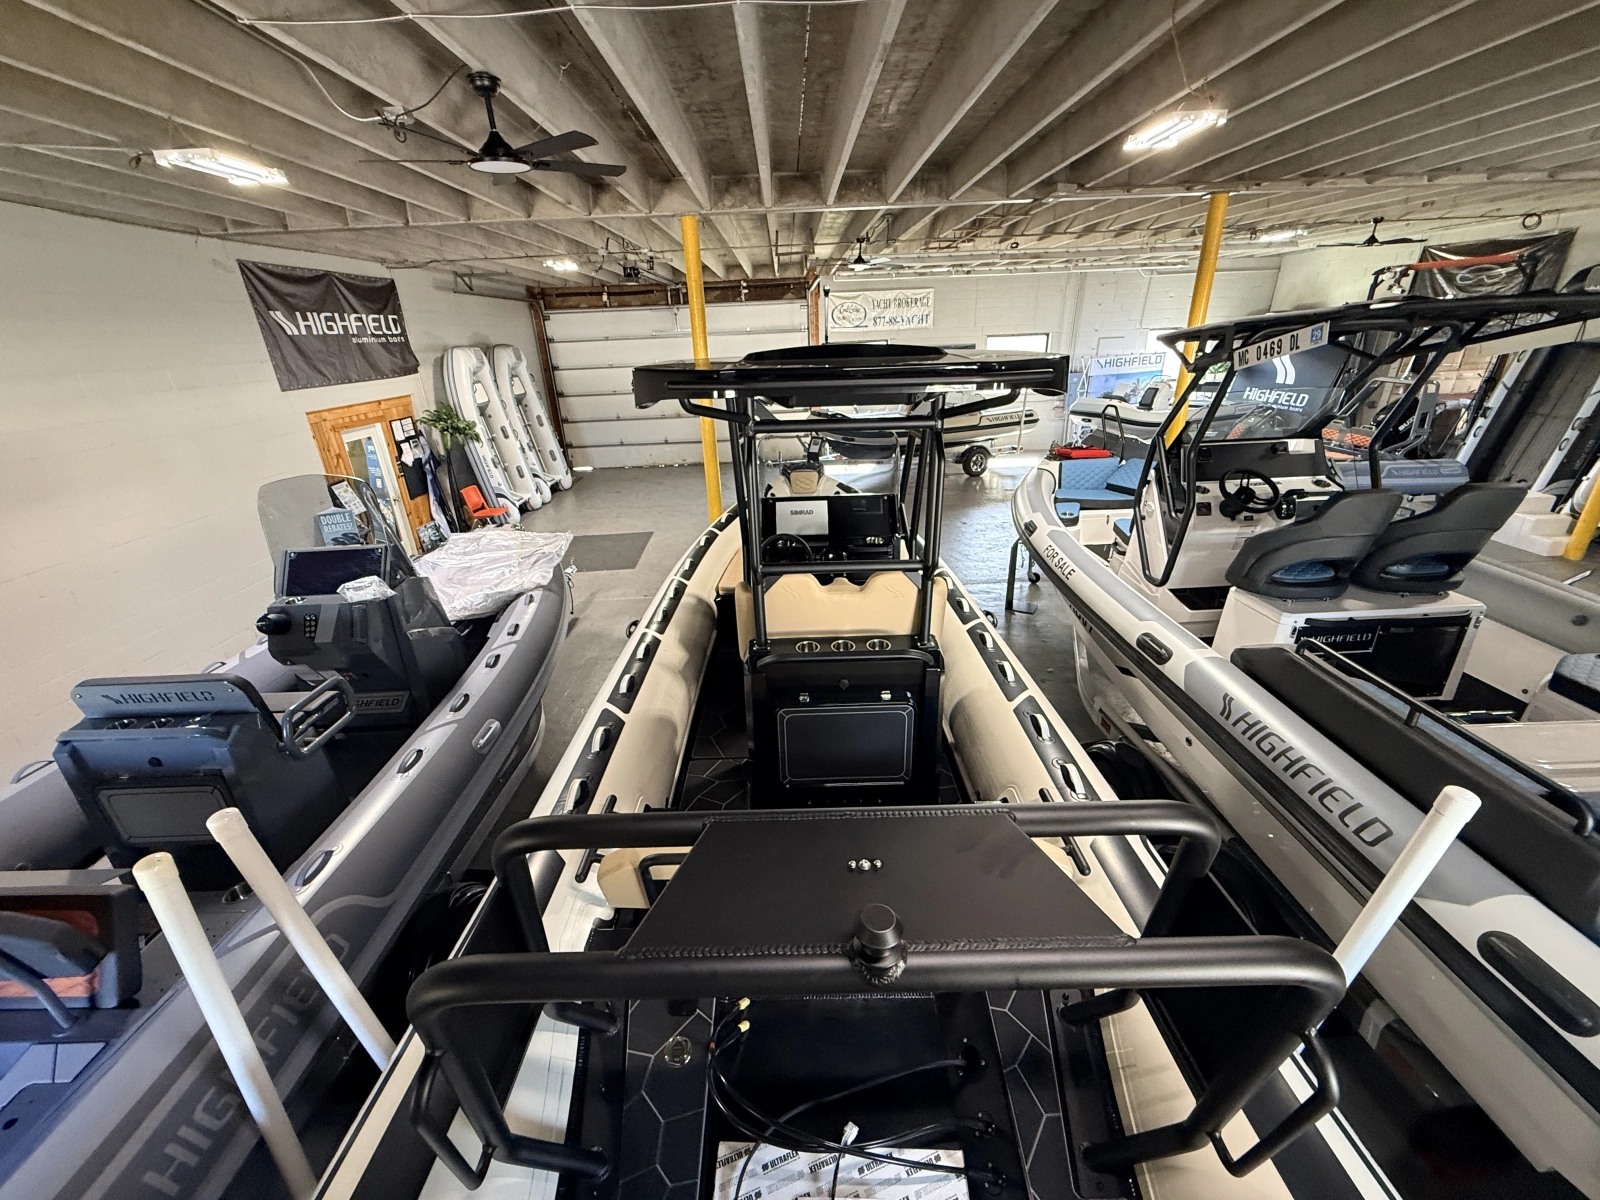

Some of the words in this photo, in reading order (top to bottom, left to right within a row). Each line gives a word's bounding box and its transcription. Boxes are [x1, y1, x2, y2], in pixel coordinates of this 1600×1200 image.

[871, 298, 891, 310] YACHT
[893, 296, 930, 309] BROKERAGE
[295, 311, 402, 335] HIGHFIELD
[872, 313, 930, 327] 877-88-YACHT
[1312, 329, 1321, 341] 29
[1238, 349, 1249, 367] MC
[1256, 338, 1282, 361] 0469
[1289, 332, 1300, 352] DL
[1104, 355, 1163, 368] HIGHFIELD
[1243, 386, 1309, 407] HIGHFIELD
[320, 512, 352, 525] DOUBLE
[323, 522, 354, 534] REBATES!
[1043, 544, 1059, 564] FOR
[1054, 557, 1076, 581] SALE
[1311, 633, 1372, 643] HIGHFIELD
[119, 690, 216, 704] HIGHFIELD
[1231, 710, 1394, 848] HIGHFIELD
[716, 1151, 744, 1169] ULTRAFLE
[769, 1150, 800, 1169] ULTRAFLEX
[808, 1154, 838, 1174] ULTRAFLEX
